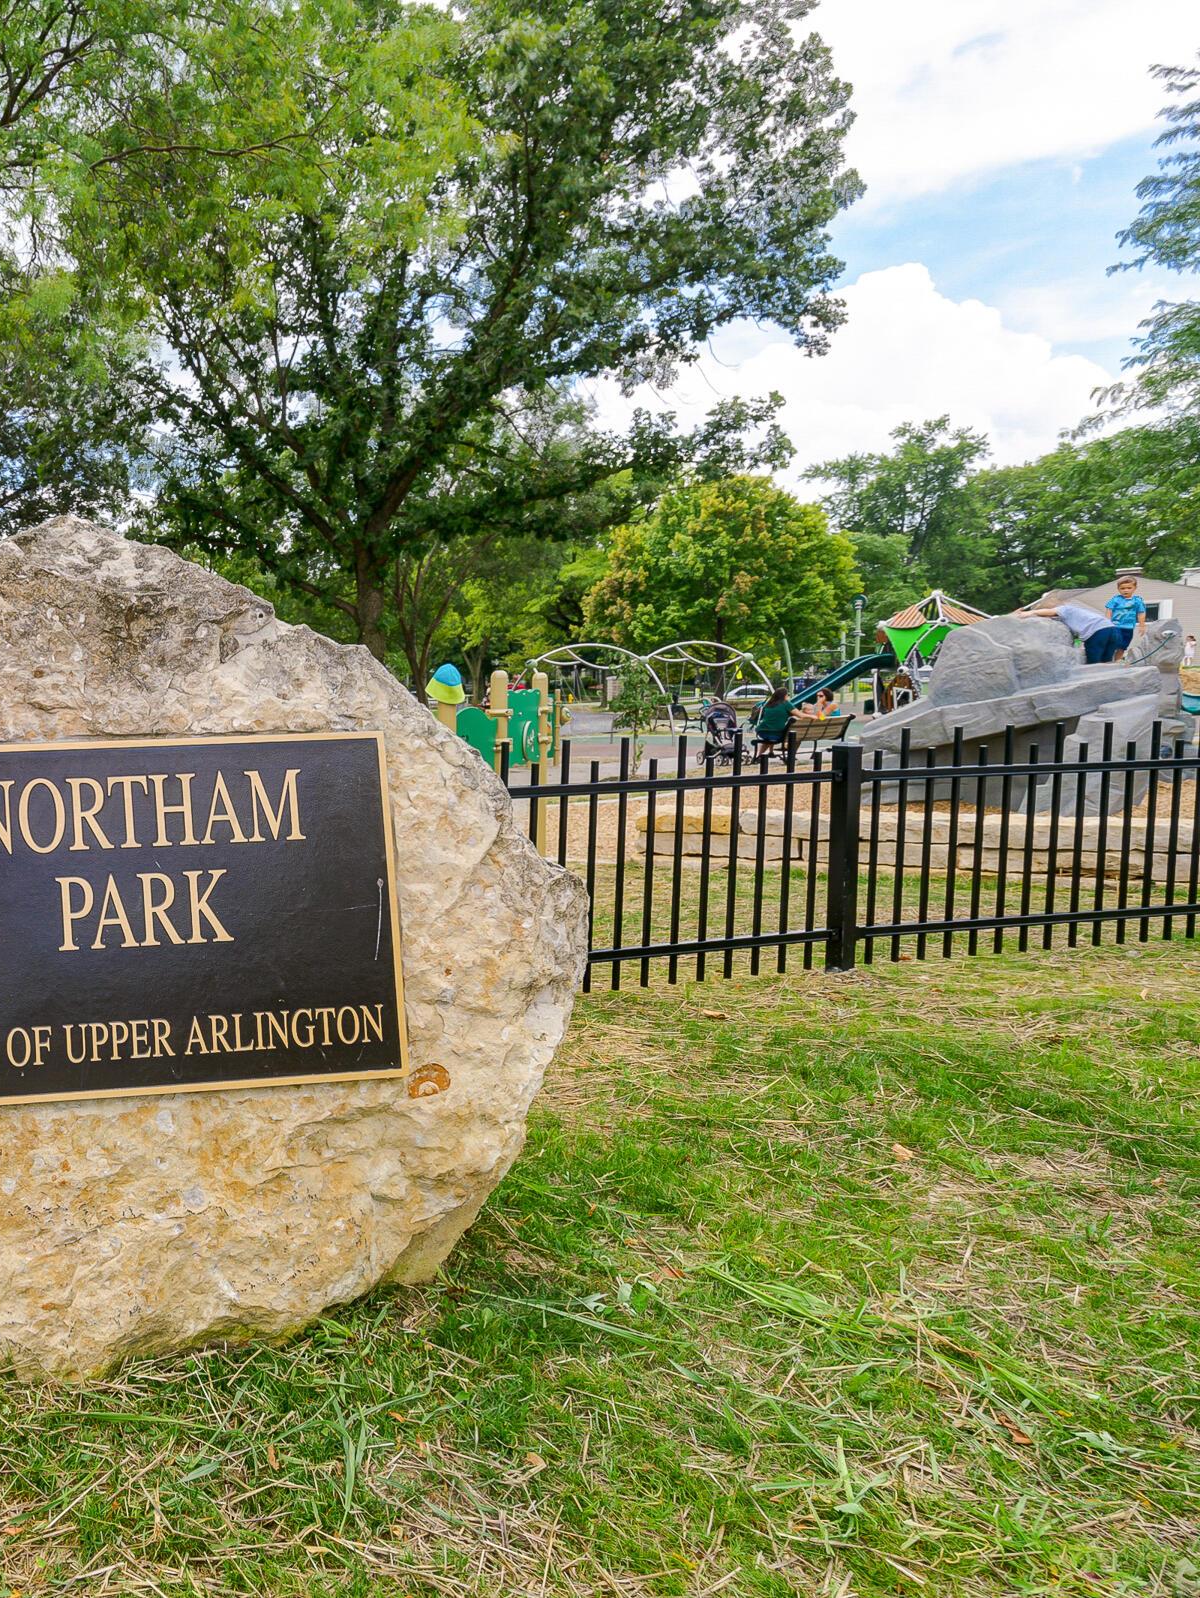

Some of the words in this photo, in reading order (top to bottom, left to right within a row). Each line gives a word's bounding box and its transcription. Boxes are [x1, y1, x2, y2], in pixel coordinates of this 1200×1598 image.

[55, 869, 235, 952] PARK
[6, 1026, 52, 1067] OF
[63, 1018, 176, 1064] UPPER
[184, 1004, 384, 1057] ARLINGTON
